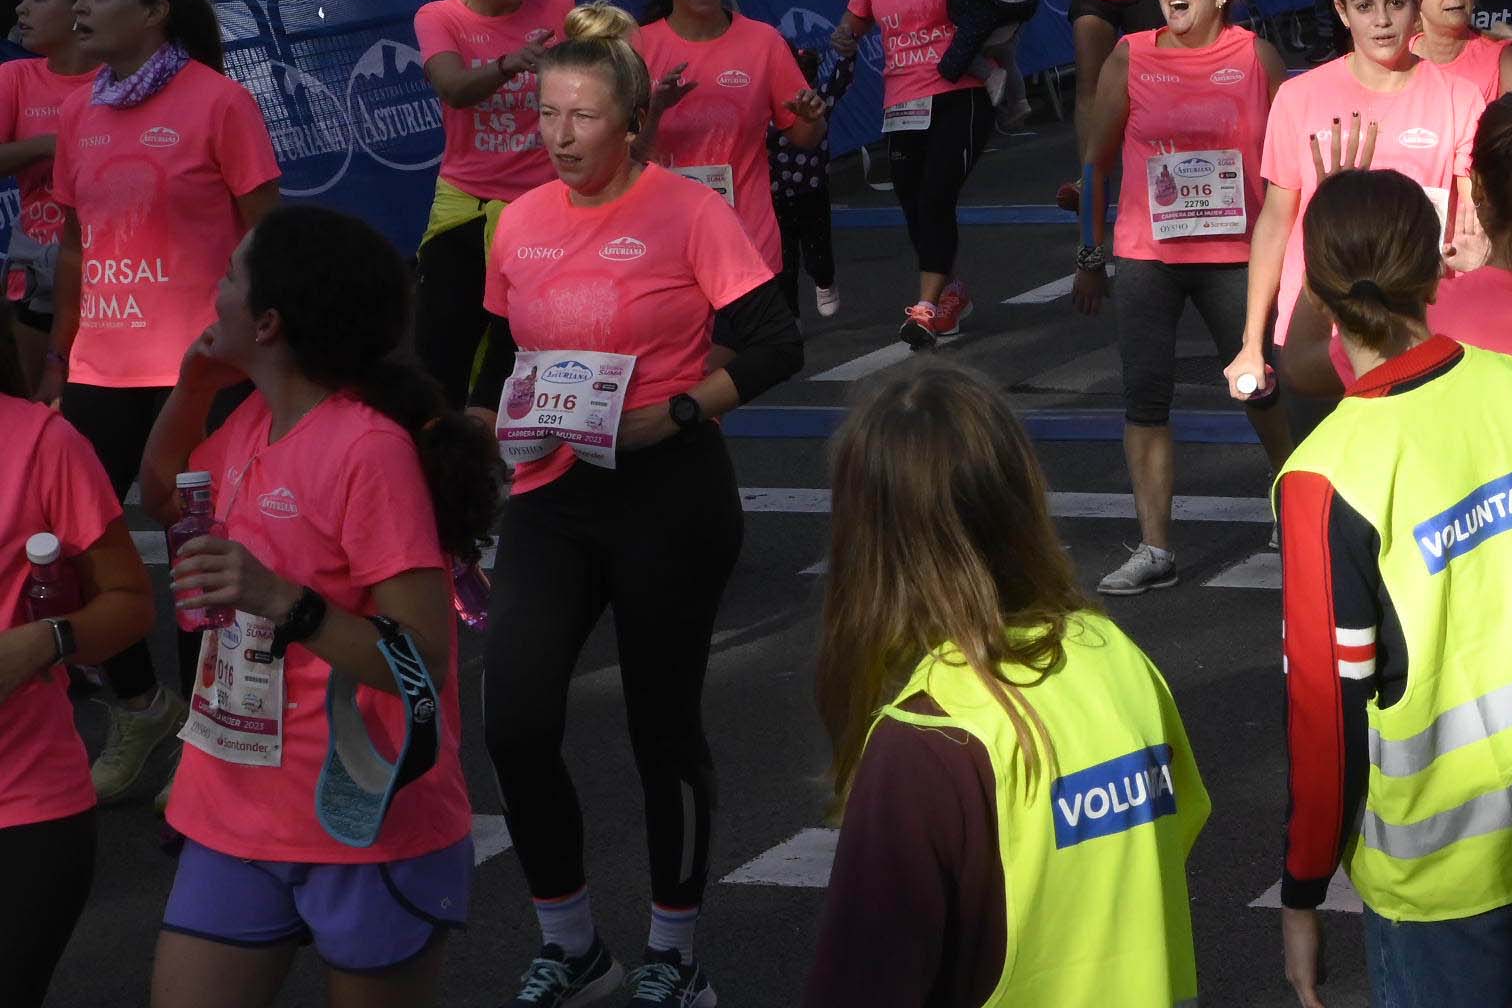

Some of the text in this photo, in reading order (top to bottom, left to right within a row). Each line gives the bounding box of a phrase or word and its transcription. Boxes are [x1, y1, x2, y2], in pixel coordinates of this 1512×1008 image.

[1180, 183, 1213, 198] 016
[1184, 199, 1211, 209] 22790
[517, 246, 566, 261] OYSHO
[536, 392, 578, 411] 016
[537, 414, 564, 426] 6291
[556, 432, 583, 441] MUJER
[245, 627, 275, 641] SUMA
[217, 659, 235, 686] 016
